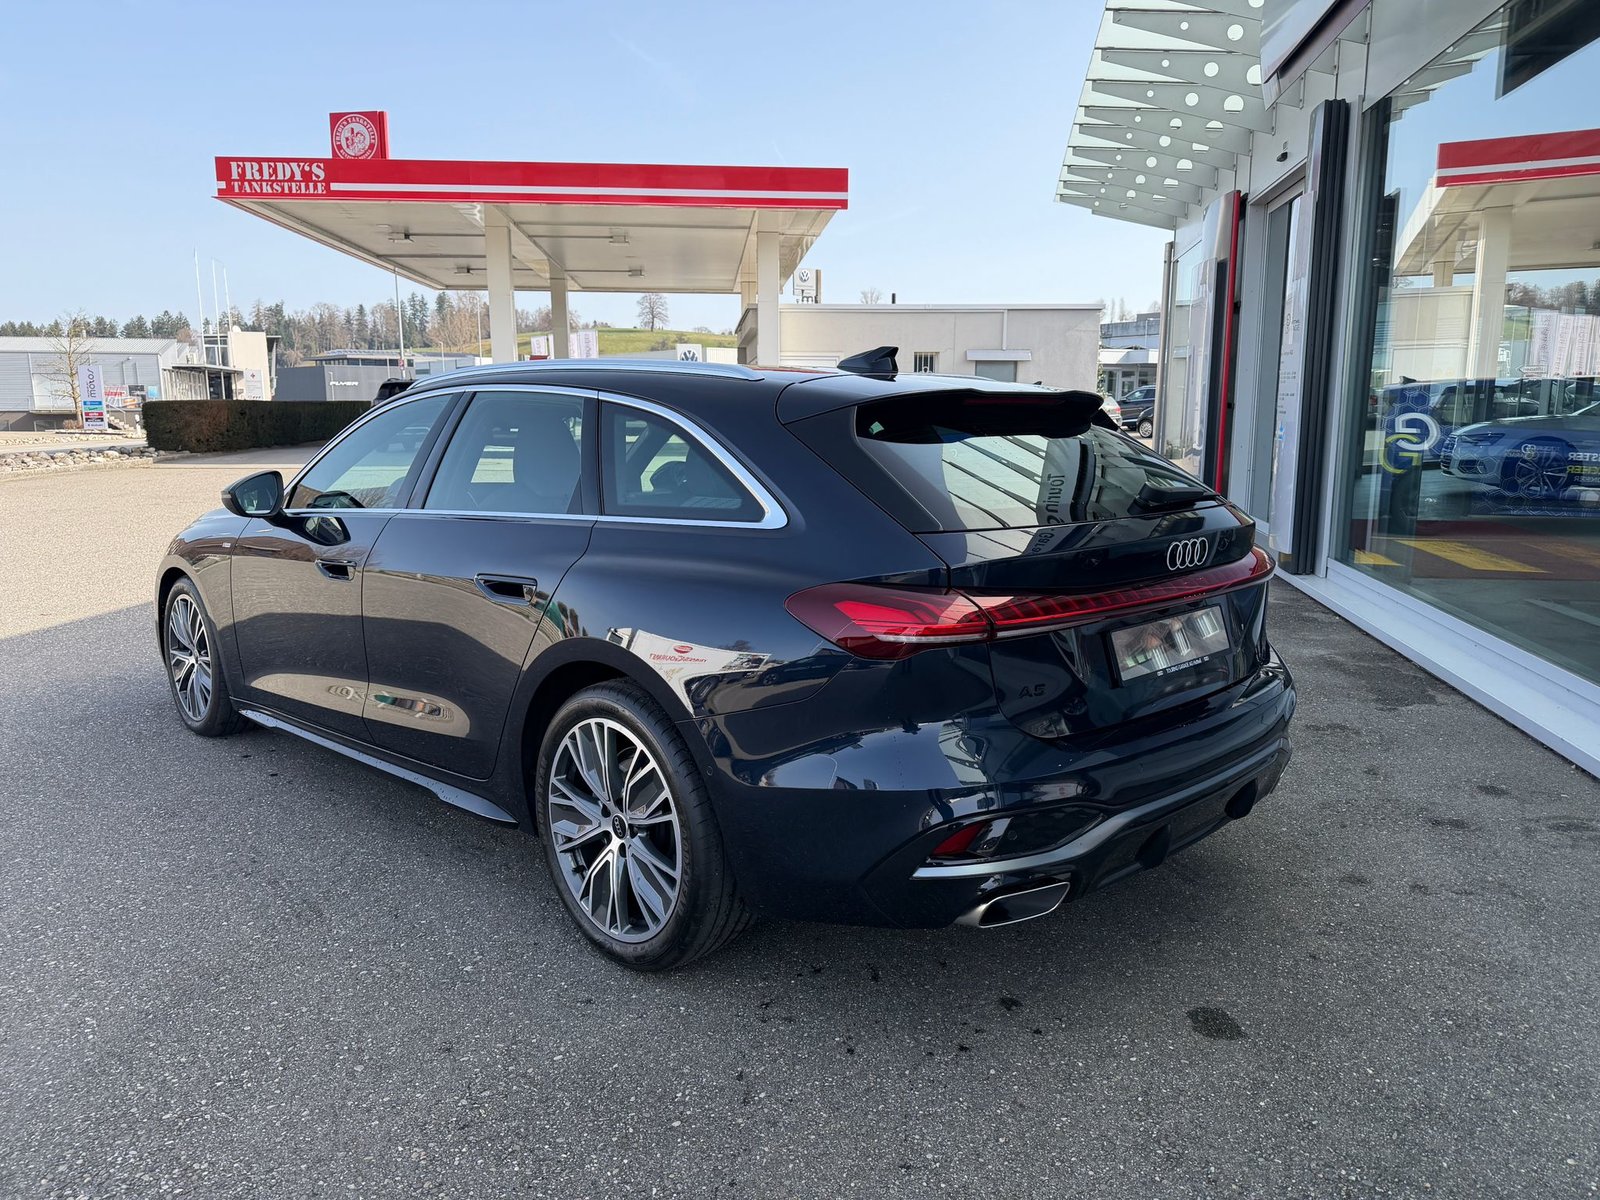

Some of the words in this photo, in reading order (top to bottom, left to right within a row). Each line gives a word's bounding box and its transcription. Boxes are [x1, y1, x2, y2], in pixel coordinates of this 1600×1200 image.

[229, 161, 325, 181] FREDY'S
[231, 181, 327, 194] TANKSTELLE
[1018, 683, 1046, 698] A5
